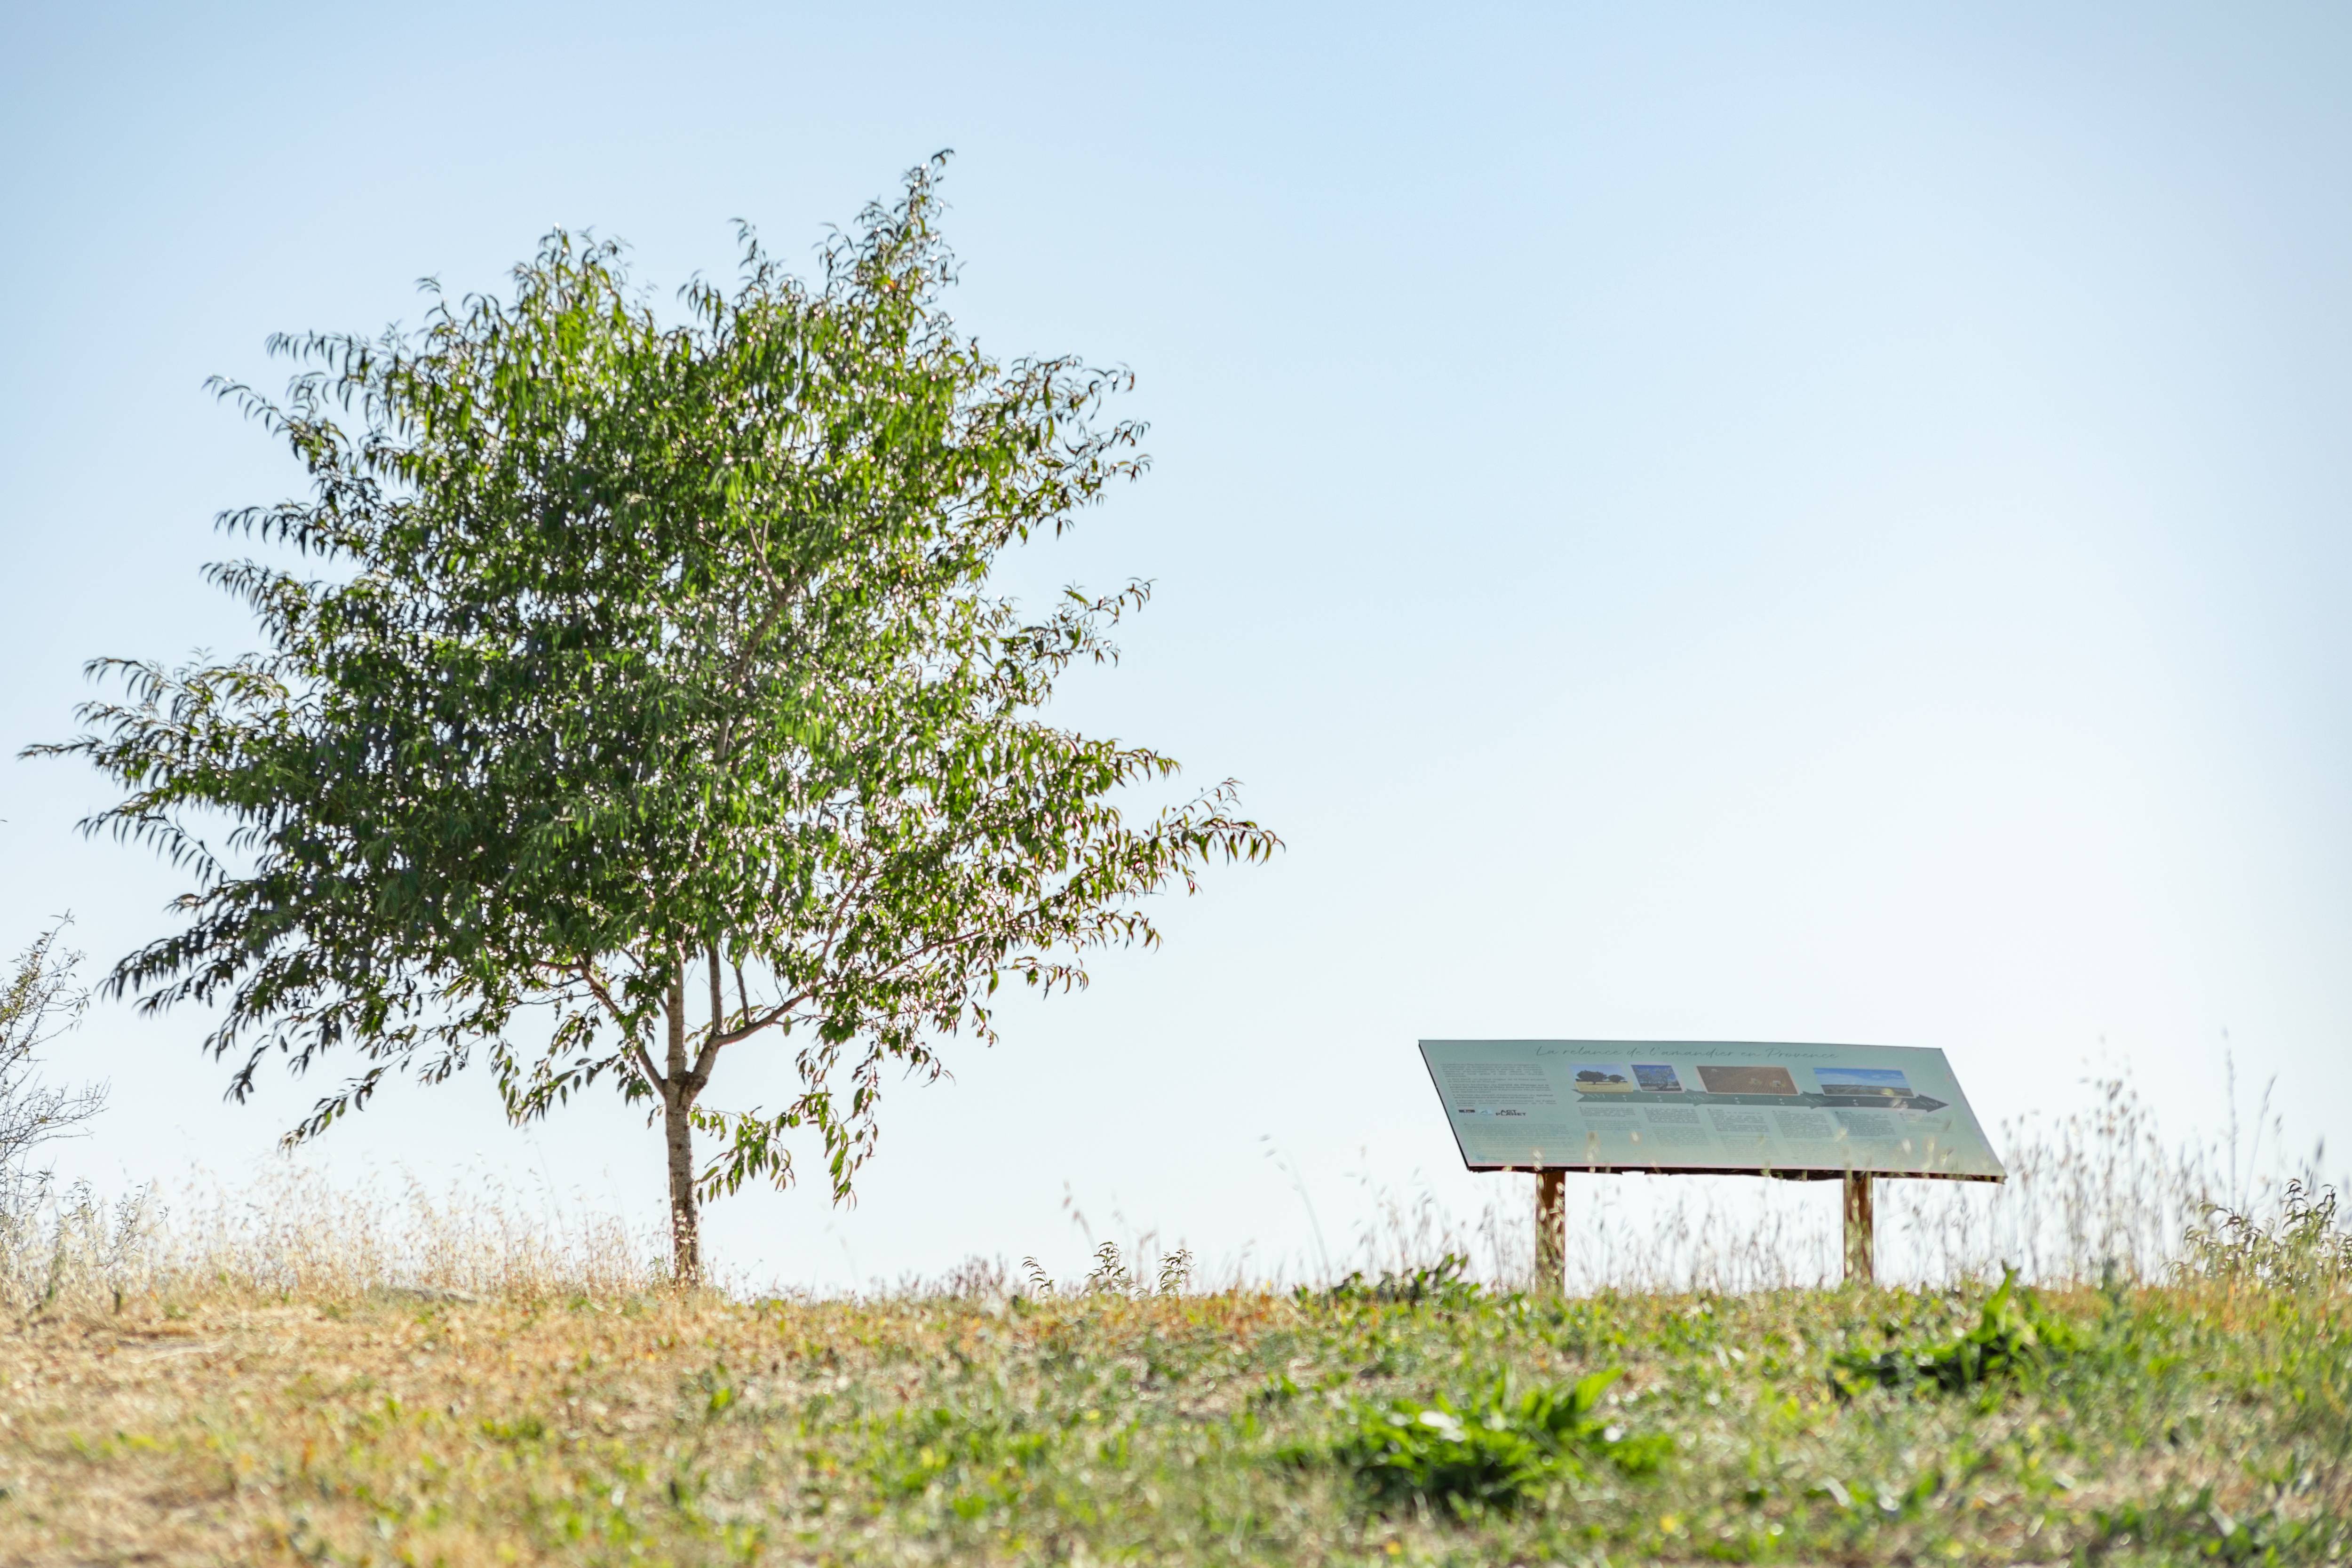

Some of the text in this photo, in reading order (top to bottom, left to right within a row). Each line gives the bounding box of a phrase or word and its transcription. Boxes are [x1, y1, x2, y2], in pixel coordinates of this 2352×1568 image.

[1536, 1046, 1557, 1056] La
[1562, 1046, 1622, 1055] relance
[1627, 1047, 1645, 1057] de
[1765, 1048, 1839, 1059] Provence
